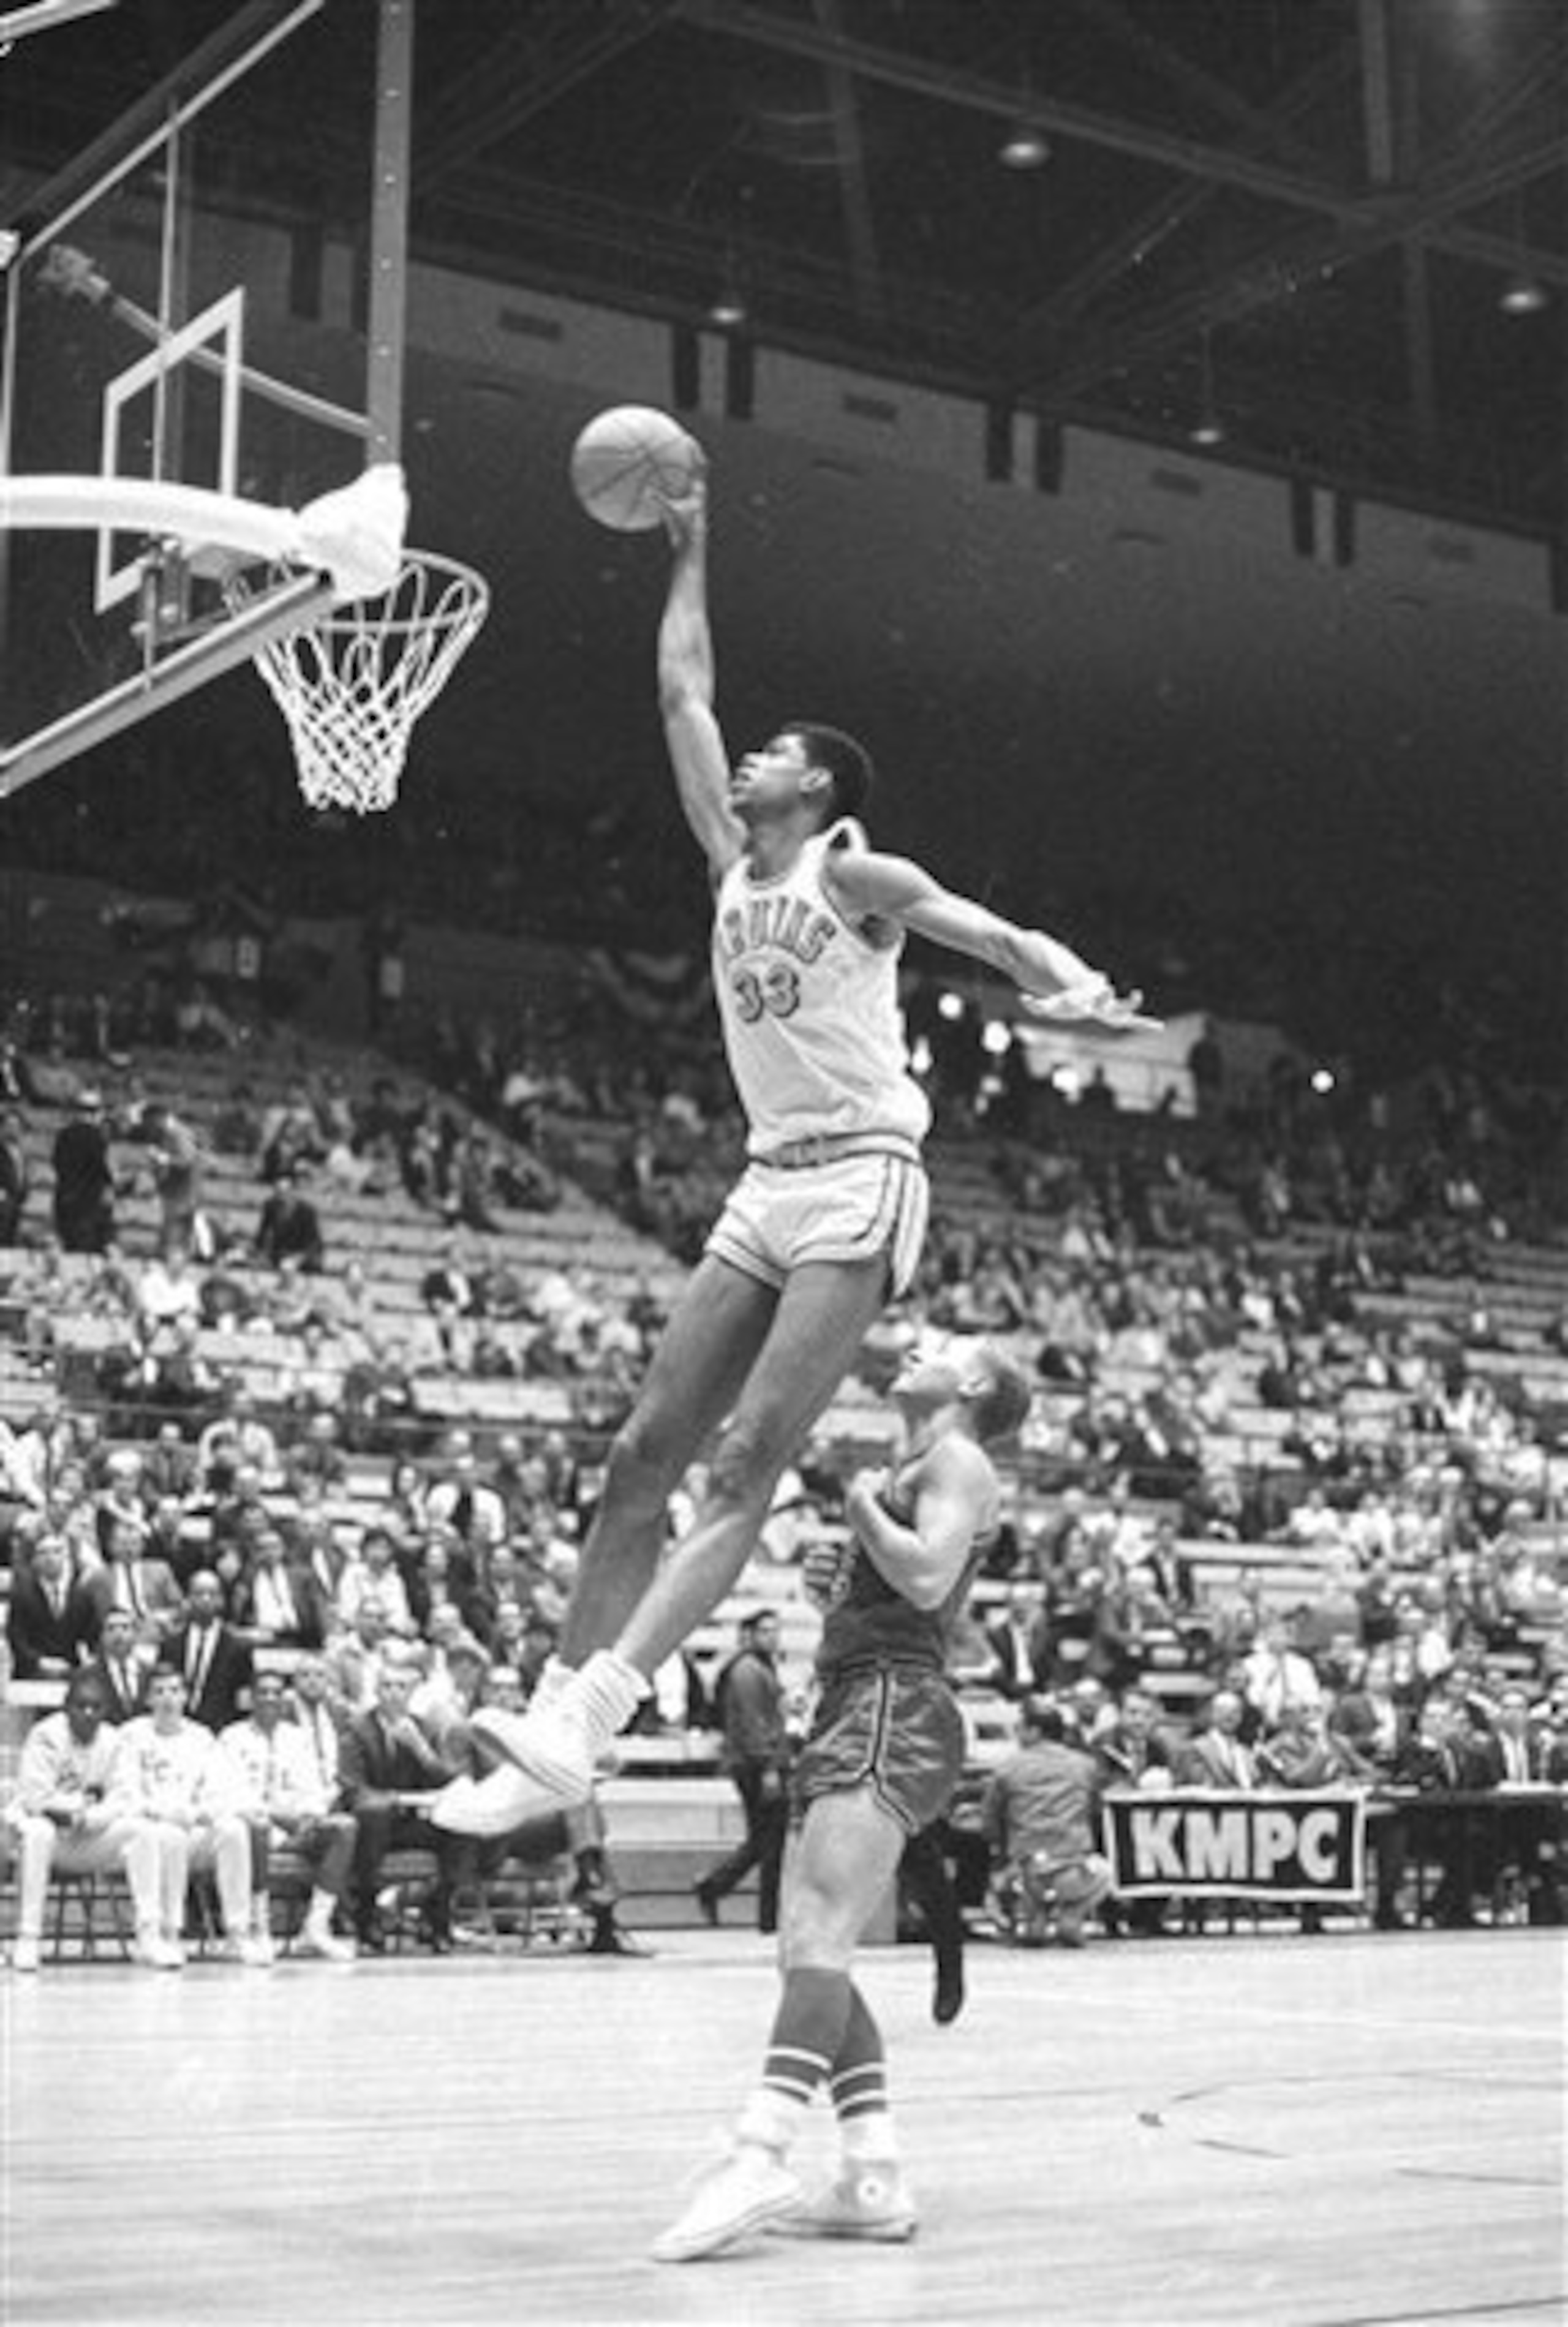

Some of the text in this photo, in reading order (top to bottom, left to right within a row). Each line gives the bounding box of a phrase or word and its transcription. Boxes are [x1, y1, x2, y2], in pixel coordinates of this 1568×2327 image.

[715, 896, 837, 964] RUINS
[733, 963, 799, 1024] 33
[1129, 1808, 1340, 1882] KMPC
